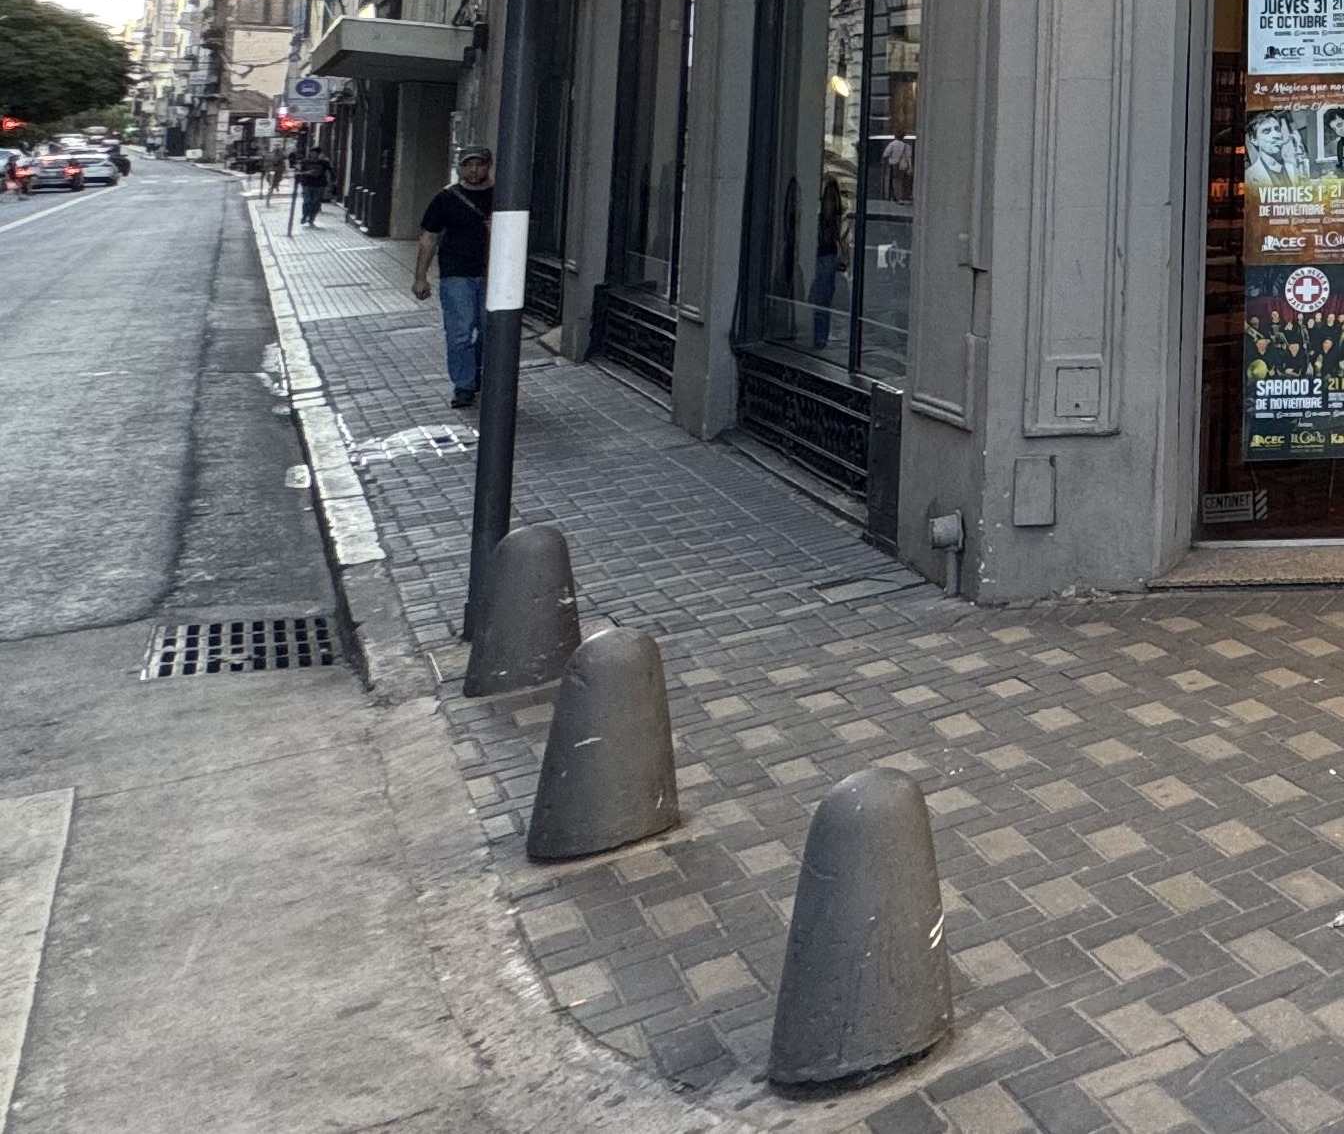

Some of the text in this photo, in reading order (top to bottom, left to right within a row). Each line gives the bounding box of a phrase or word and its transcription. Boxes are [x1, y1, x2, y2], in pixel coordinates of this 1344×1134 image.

[1260, 16, 1274, 29] DE
[1276, 15, 1328, 28] OCTUBRE
[1259, 186, 1313, 203] VIERNES
[1330, 185, 1342, 198] 21
[1259, 205, 1271, 217] DE
[1272, 204, 1326, 216] NOVIEMBRE
[1256, 378, 1323, 396] SABADO 2
[1328, 377, 1339, 391] 21
[1255, 398, 1268, 410] DE
[1270, 397, 1323, 409] NOVIEMBRE
